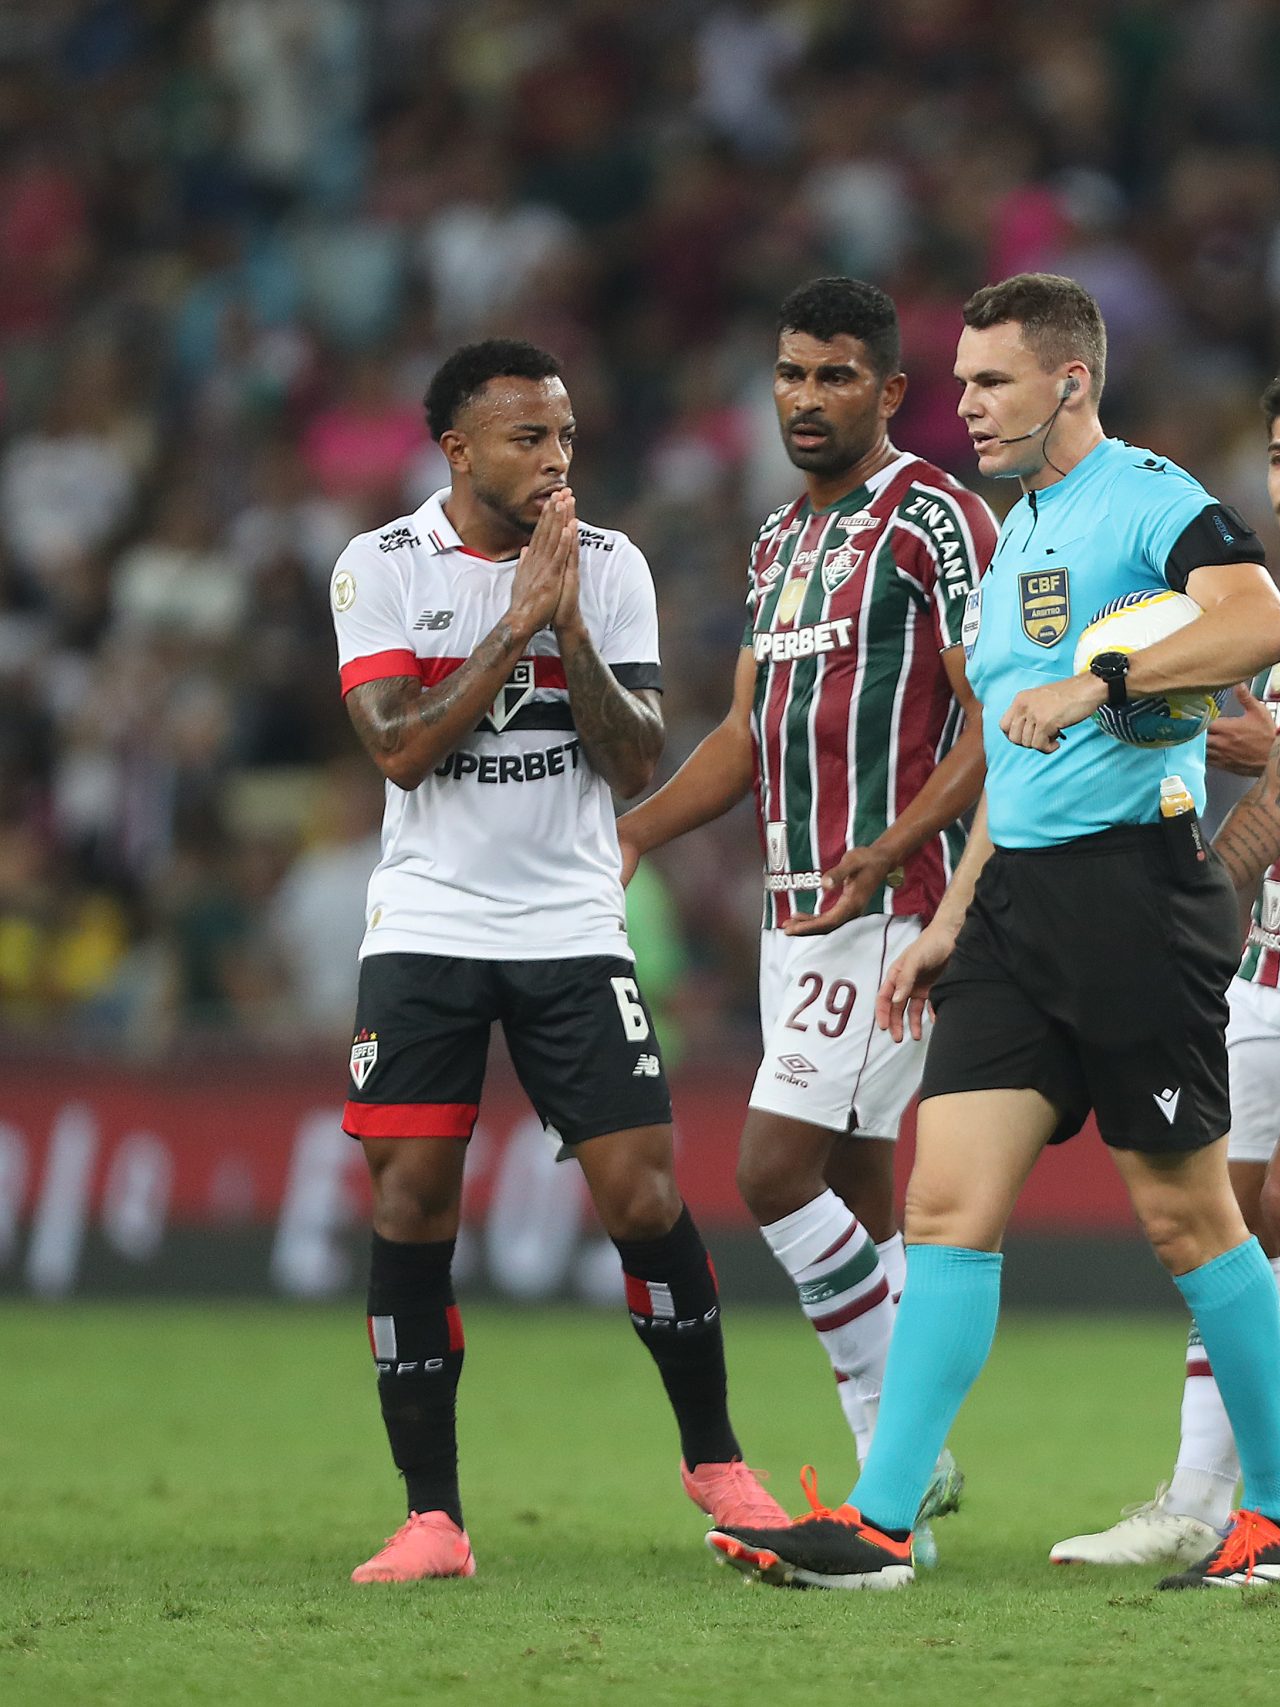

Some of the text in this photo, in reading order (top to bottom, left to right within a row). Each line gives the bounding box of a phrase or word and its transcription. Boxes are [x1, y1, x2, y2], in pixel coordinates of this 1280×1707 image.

[579, 538, 614, 552] RTE
[905, 495, 970, 601] ZINZANE
[1027, 574, 1060, 595] CBF
[752, 617, 854, 663] PERBET
[433, 739, 581, 785] UPERBET
[609, 976, 650, 1043] 6
[784, 970, 857, 1038] 29
[354, 1046, 375, 1059] SPFC
[774, 1071, 808, 1089] umbro
[375, 1357, 444, 1376] PFC
